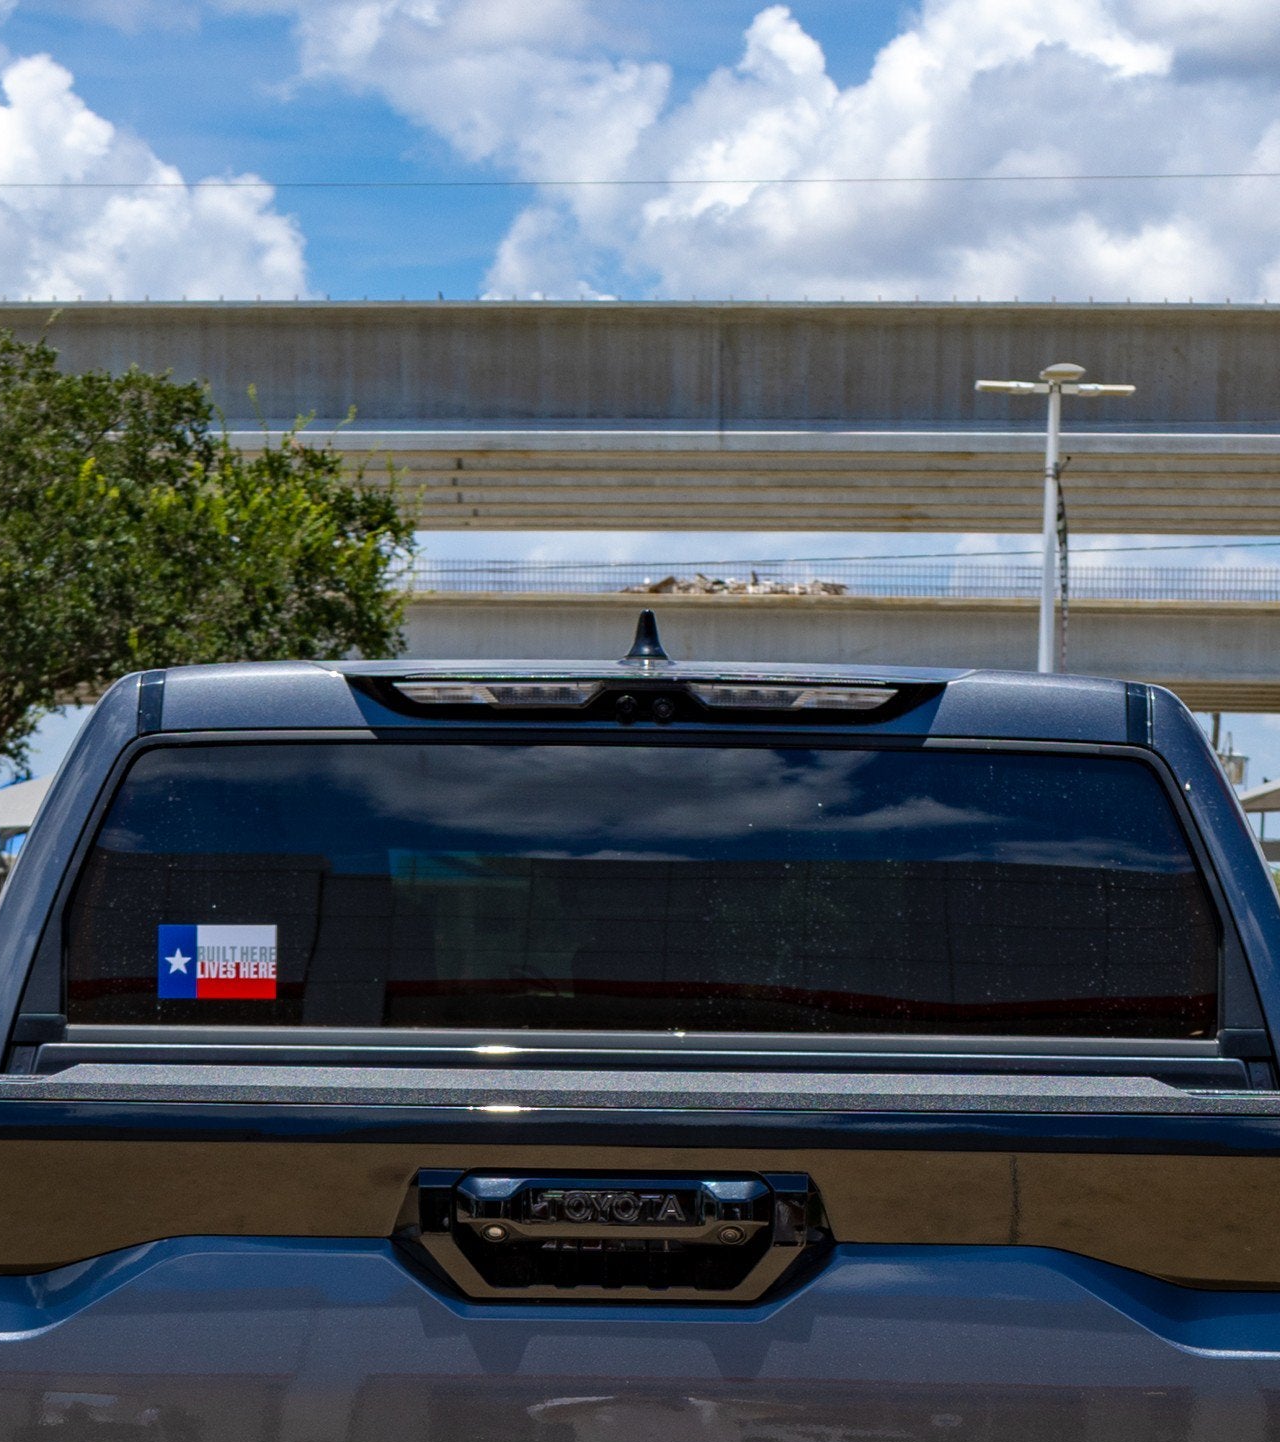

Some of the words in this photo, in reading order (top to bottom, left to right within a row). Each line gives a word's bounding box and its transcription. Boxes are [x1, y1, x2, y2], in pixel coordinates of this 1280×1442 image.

[197, 946, 237, 962] BUILT
[241, 946, 277, 962] HERE
[197, 962, 236, 979] LIVES
[239, 962, 277, 979] HERE
[543, 1190, 686, 1222] TOYOTA
